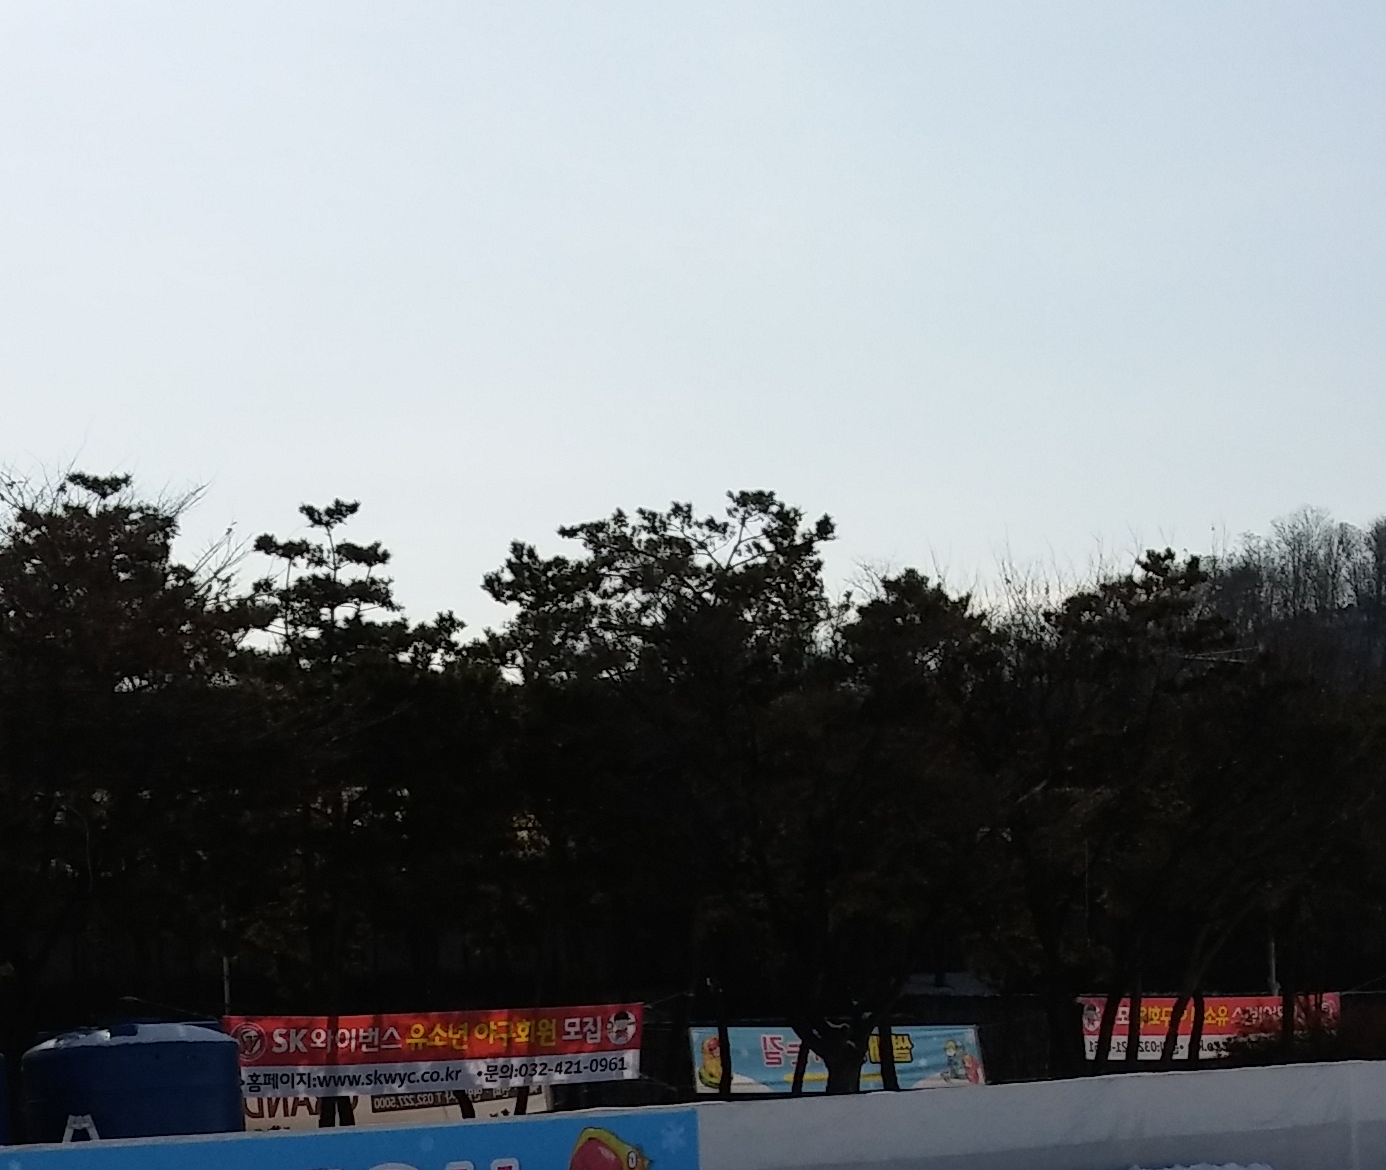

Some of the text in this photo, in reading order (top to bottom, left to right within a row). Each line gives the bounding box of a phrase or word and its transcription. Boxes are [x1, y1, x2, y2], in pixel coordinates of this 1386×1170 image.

[271, 1014, 603, 1054] SK와이번스 유소년 야구회원 모집
[246, 1065, 462, 1093] 홈페이지:www.skwyc.co.kr
